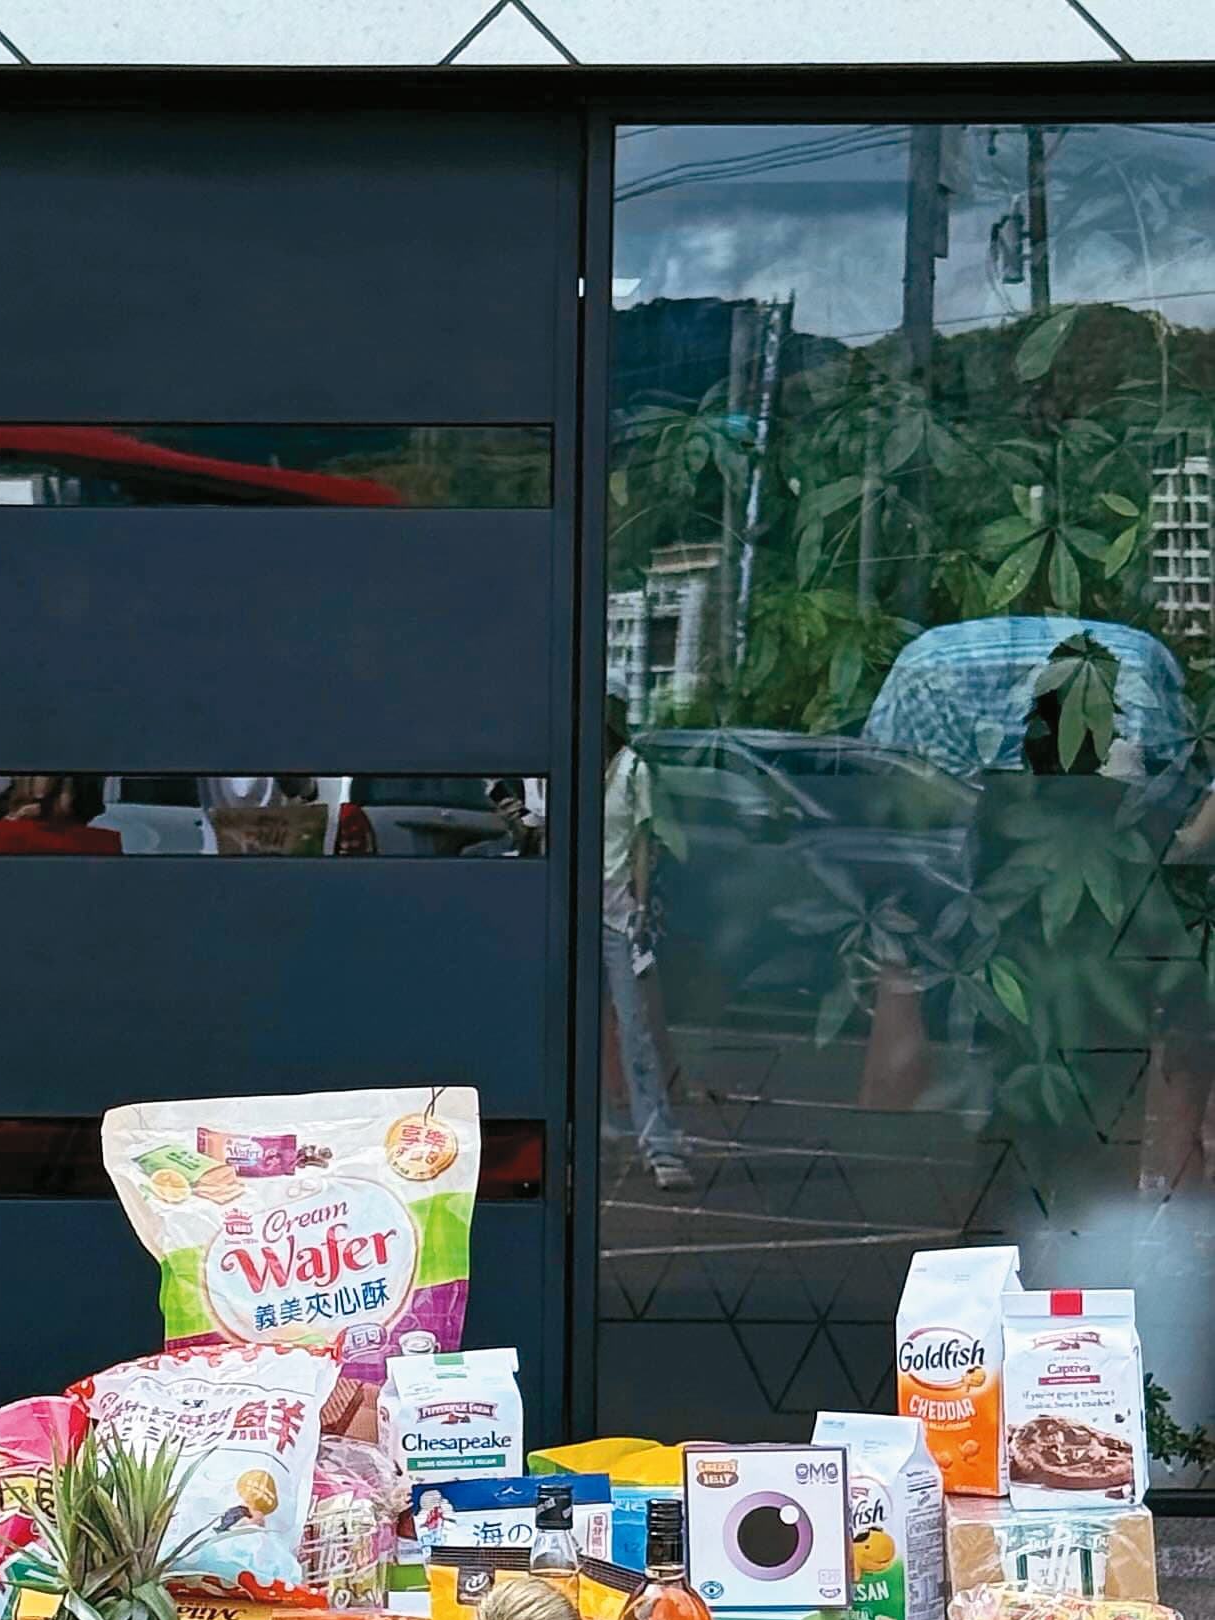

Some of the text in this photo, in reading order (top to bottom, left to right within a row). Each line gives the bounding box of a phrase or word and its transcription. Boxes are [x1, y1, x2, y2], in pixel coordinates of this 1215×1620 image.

[263, 1201, 349, 1242] Cream
[221, 1223, 397, 1294] Wafer
[254, 1277, 390, 1332] 義美夾心酥
[898, 1338, 985, 1373] Goldfish
[908, 1394, 977, 1421] CHEDDAR
[401, 1430, 512, 1455] Chesapeake
[473, 1521, 533, 1547] 海の
